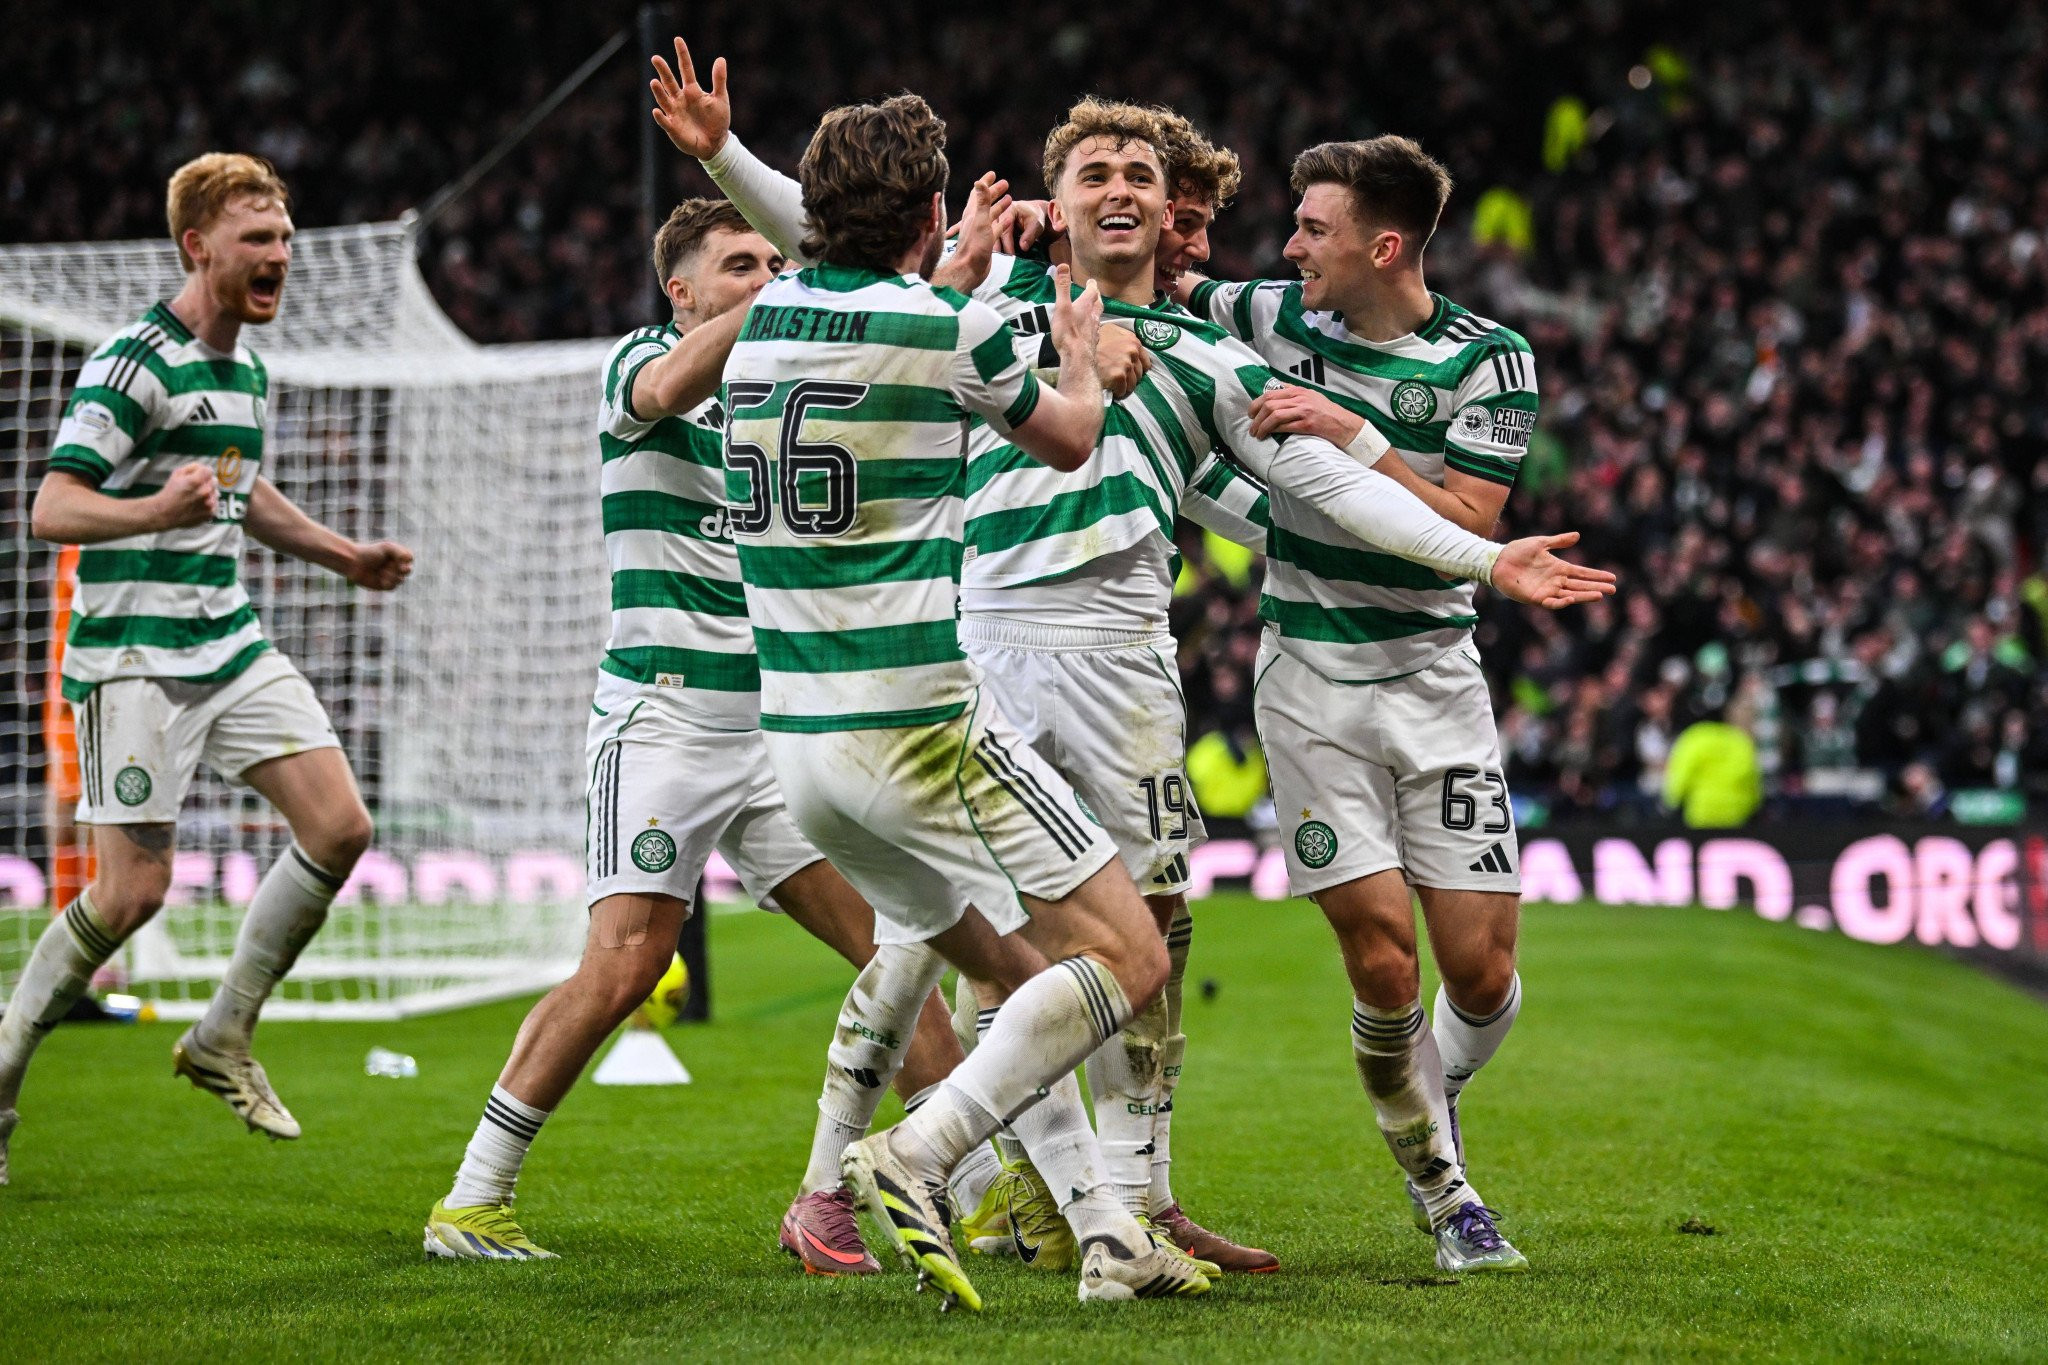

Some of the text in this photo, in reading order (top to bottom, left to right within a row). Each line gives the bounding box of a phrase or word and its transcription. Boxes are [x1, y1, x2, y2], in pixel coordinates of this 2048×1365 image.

[745, 306, 872, 342] RALSTON
[1494, 407, 1529, 430] CELTIC
[725, 378, 870, 538] 56
[1138, 775, 1188, 841] 19
[1441, 768, 1510, 834] 63
[852, 1021, 901, 1050] CELTIC
[1396, 1121, 1438, 1149] CELTIC
